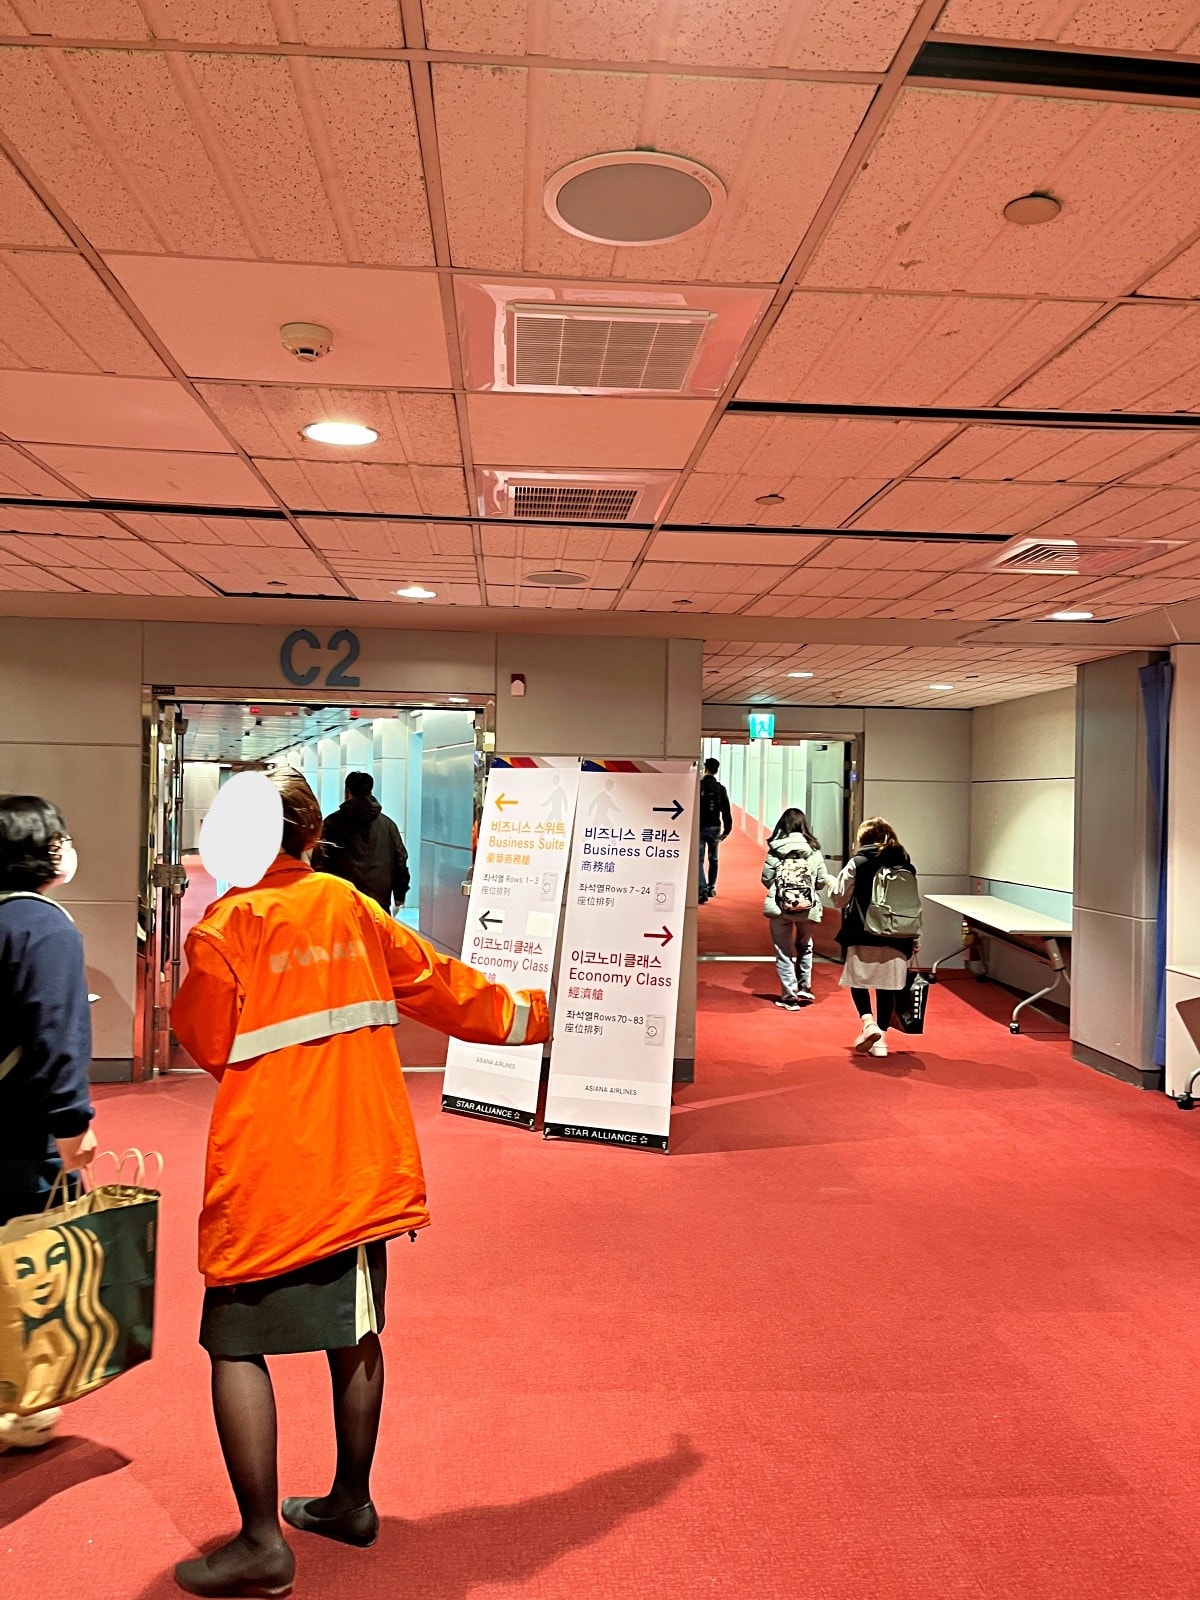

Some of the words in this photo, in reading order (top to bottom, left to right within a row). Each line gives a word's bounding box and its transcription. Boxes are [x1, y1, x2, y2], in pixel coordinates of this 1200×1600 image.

[280, 629, 360, 687] C2
[491, 820, 531, 834] 비즈니스
[534, 822, 565, 834] 스위트
[585, 827, 636, 840] 비즈니스
[641, 829, 680, 842] 클래스
[489, 836, 534, 849] Business
[538, 838, 564, 850] Suite
[584, 844, 640, 856] Business
[645, 846, 680, 858] Class
[581, 861, 615, 873] 商務艙
[506, 875, 523, 883] Rows
[579, 884, 604, 893] 좌석열
[606, 885, 627, 893] Rows
[629, 886, 650, 894] 7~24
[577, 896, 614, 907] 座位排列
[473, 937, 512, 952] 이코노미
[514, 940, 542, 955] 클래스
[471, 953, 519, 972] Economy
[522, 958, 549, 972] Class
[571, 950, 621, 967] 이코노미
[624, 953, 662, 968] 클래스
[570, 967, 631, 987] Economy
[636, 972, 672, 986] Class
[568, 986, 604, 1000] 經濟艙
[566, 1010, 593, 1021] 좌석열
[594, 1012, 616, 1022] Rows
[617, 1015, 644, 1024] 70~83
[565, 1023, 603, 1036] 座位排列
[476, 1057, 493, 1065] ASIANA
[495, 1060, 516, 1070] AIRLINES
[584, 1085, 607, 1093] ASIANA
[609, 1087, 637, 1095] AIRLINES
[456, 1100, 475, 1110] STAR
[475, 1105, 512, 1118] ALLIANCE
[564, 1128, 589, 1137] STAR
[591, 1130, 638, 1143] ALLIANCE
